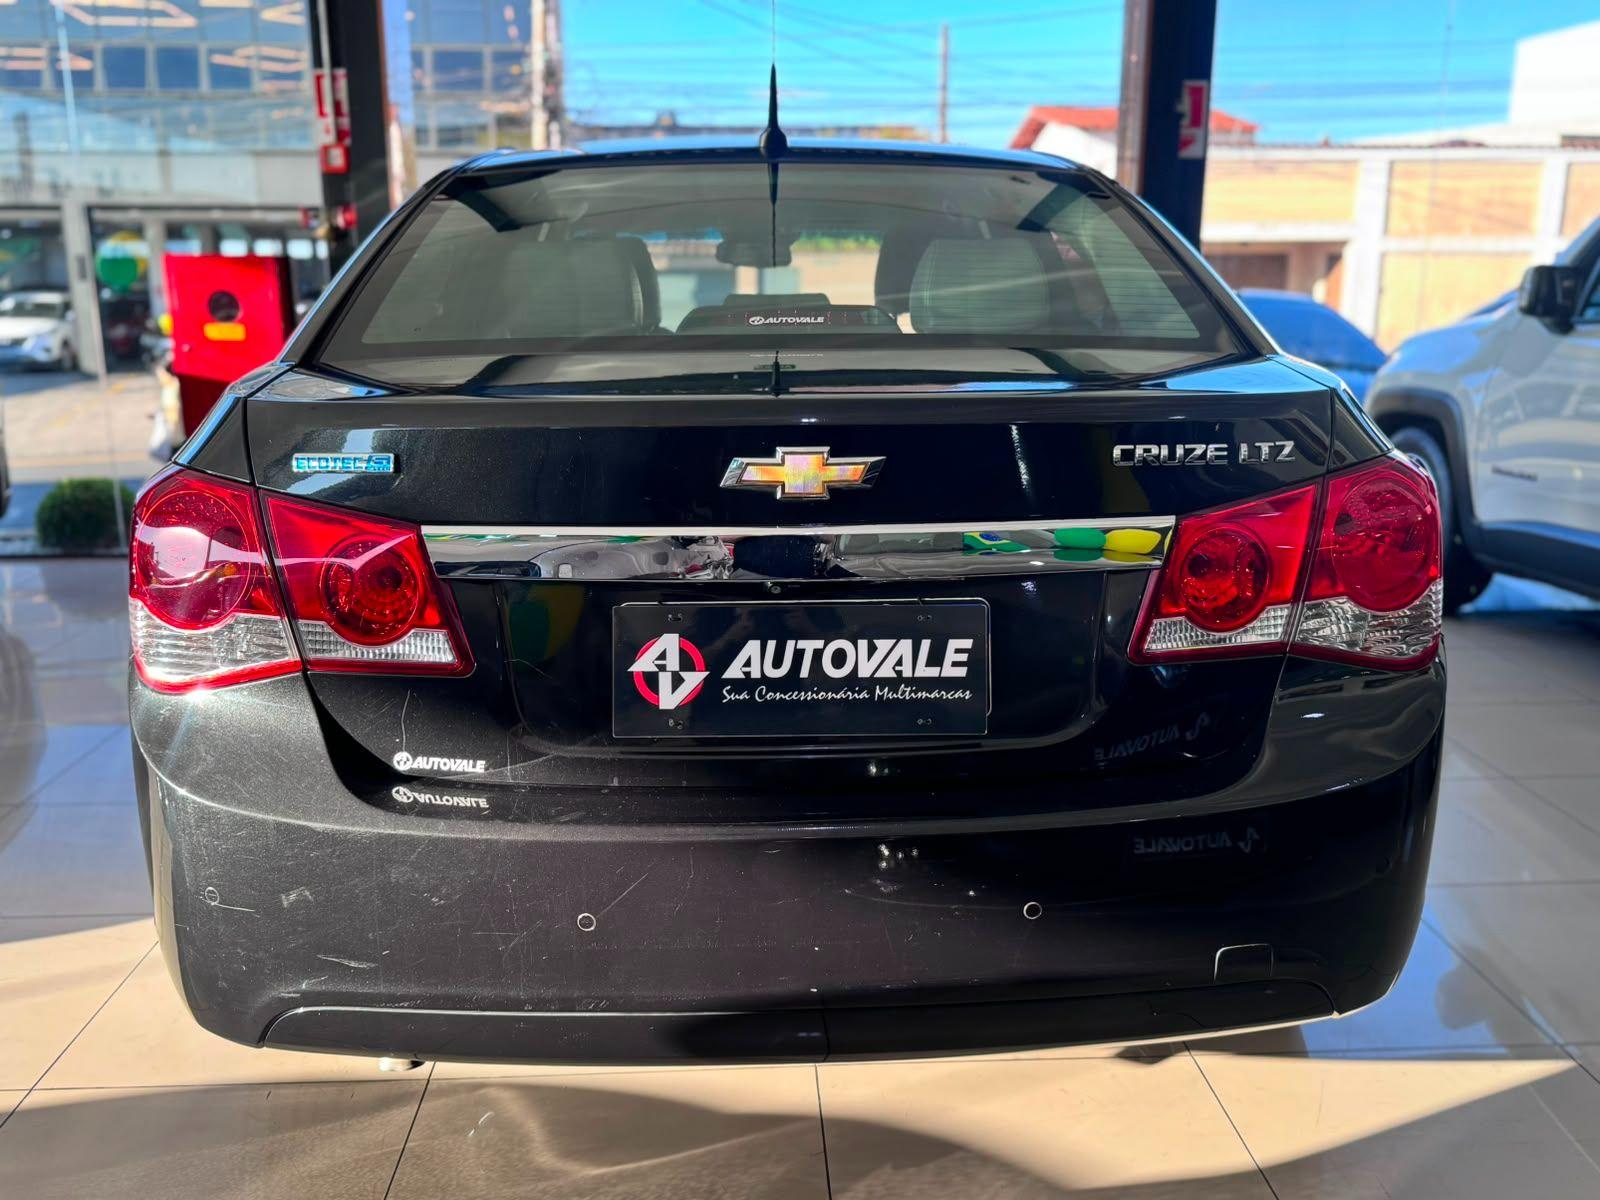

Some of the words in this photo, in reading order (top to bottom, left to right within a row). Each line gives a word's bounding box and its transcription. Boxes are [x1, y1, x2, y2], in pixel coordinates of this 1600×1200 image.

[764, 315, 825, 324] AUTOVALE
[1112, 443, 1229, 467] CRUZE
[1238, 440, 1296, 465] LTZ
[294, 455, 365, 472] ECOTEC
[721, 638, 974, 679] AUTOVALE
[722, 685, 748, 703] Sua
[755, 685, 870, 702] Concessionária
[874, 683, 973, 702] Multimarcas
[411, 756, 486, 773] AUTOVALE
